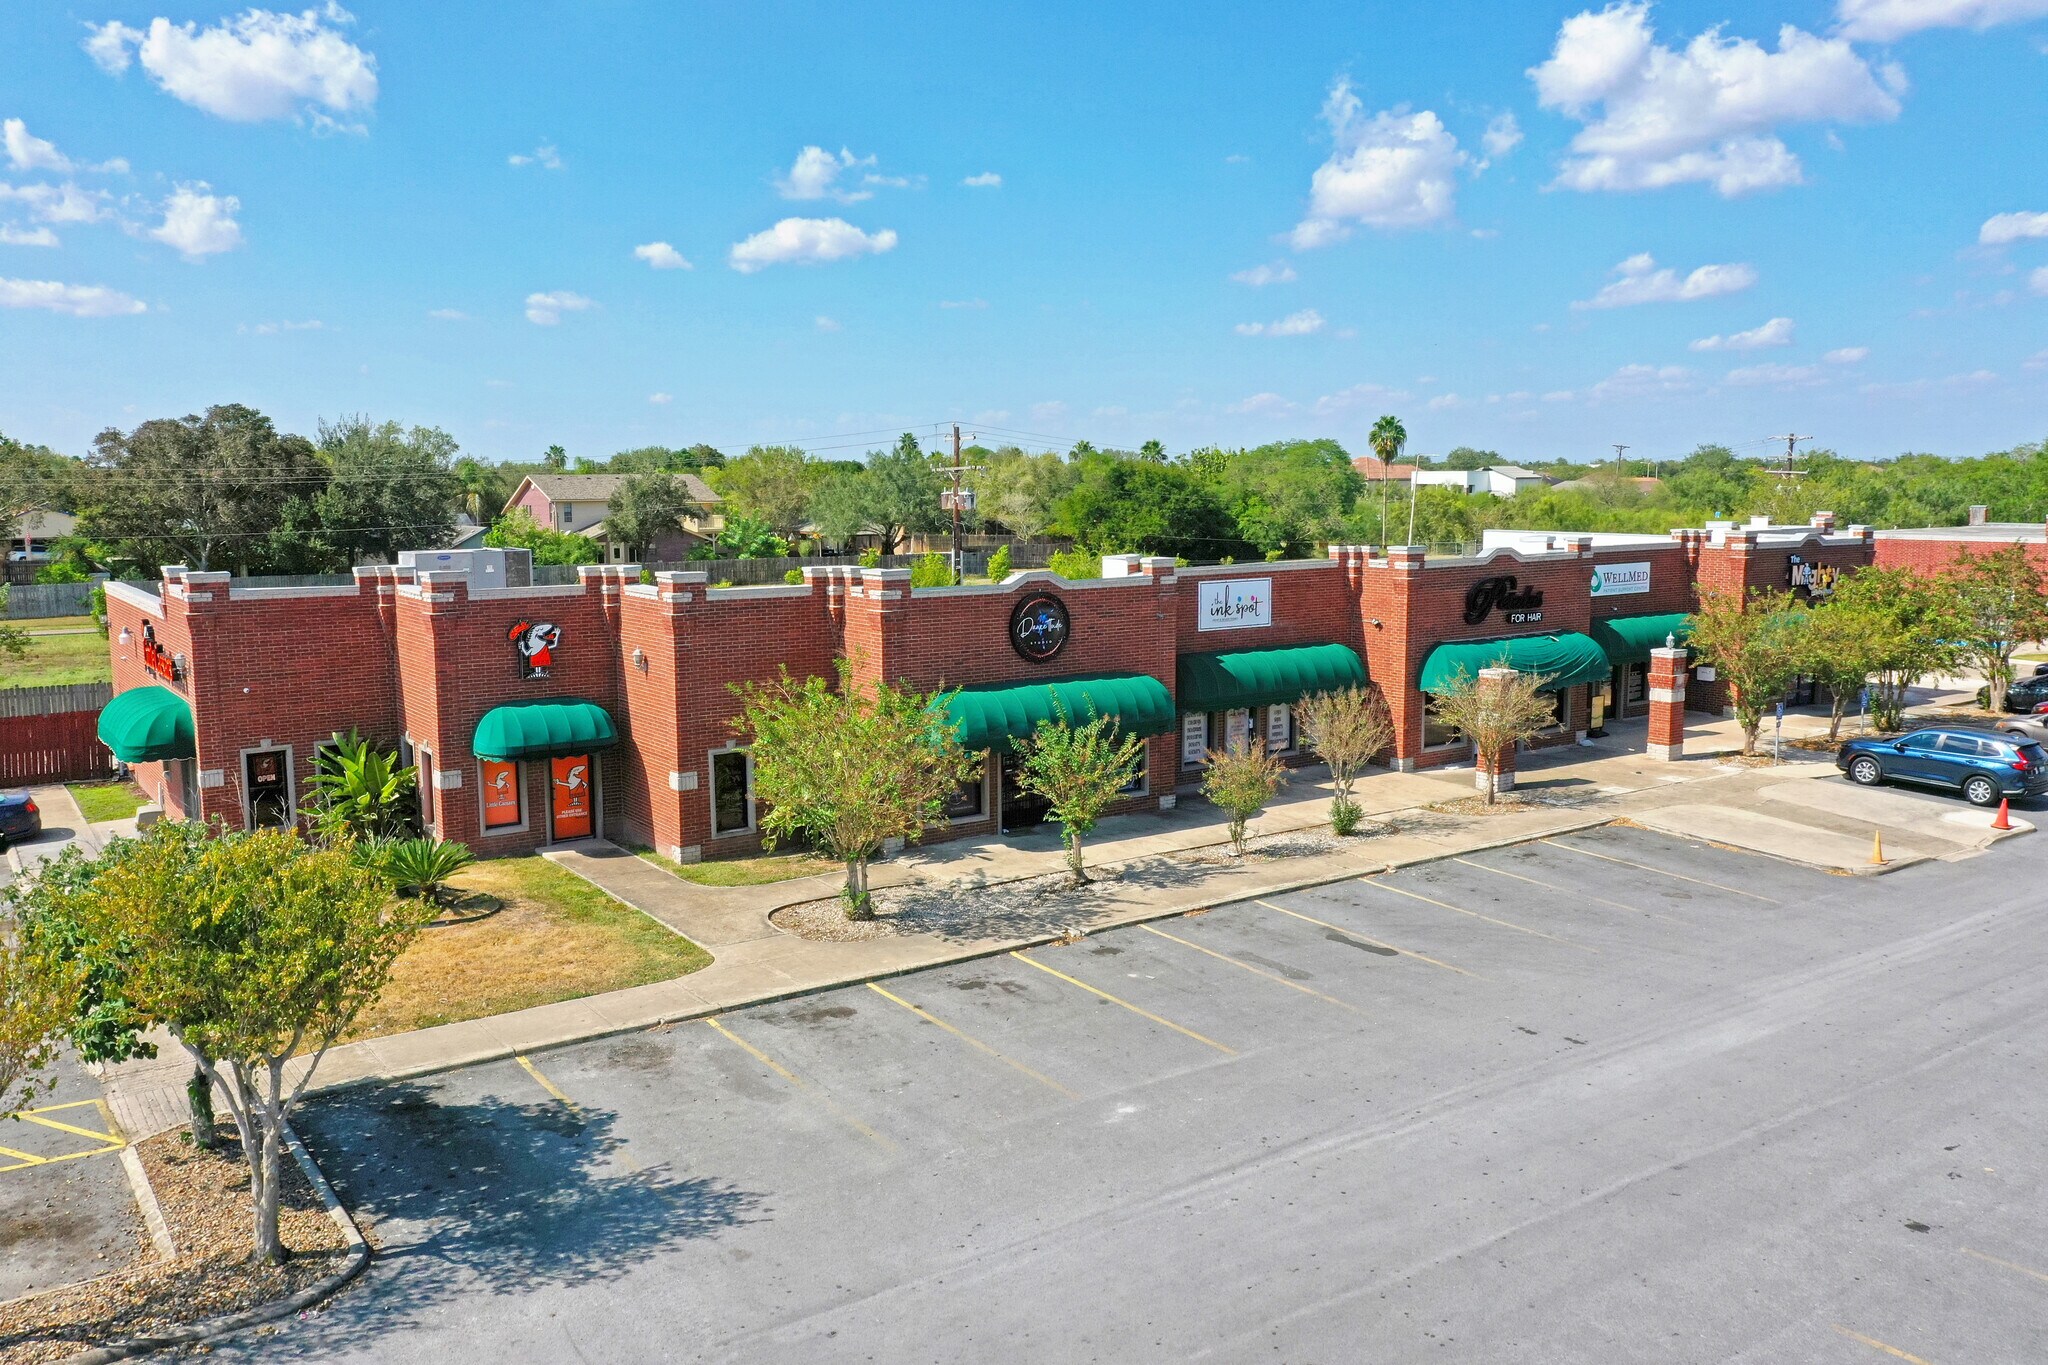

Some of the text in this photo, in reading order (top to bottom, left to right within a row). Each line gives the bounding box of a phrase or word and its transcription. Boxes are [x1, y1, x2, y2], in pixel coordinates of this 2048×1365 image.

[1790, 554, 1801, 563] The
[1210, 584, 1264, 619] ink spot
[1214, 592, 1222, 604] the
[1511, 612, 1542, 623] FOR HAIR
[257, 773, 276, 783] OPEN
